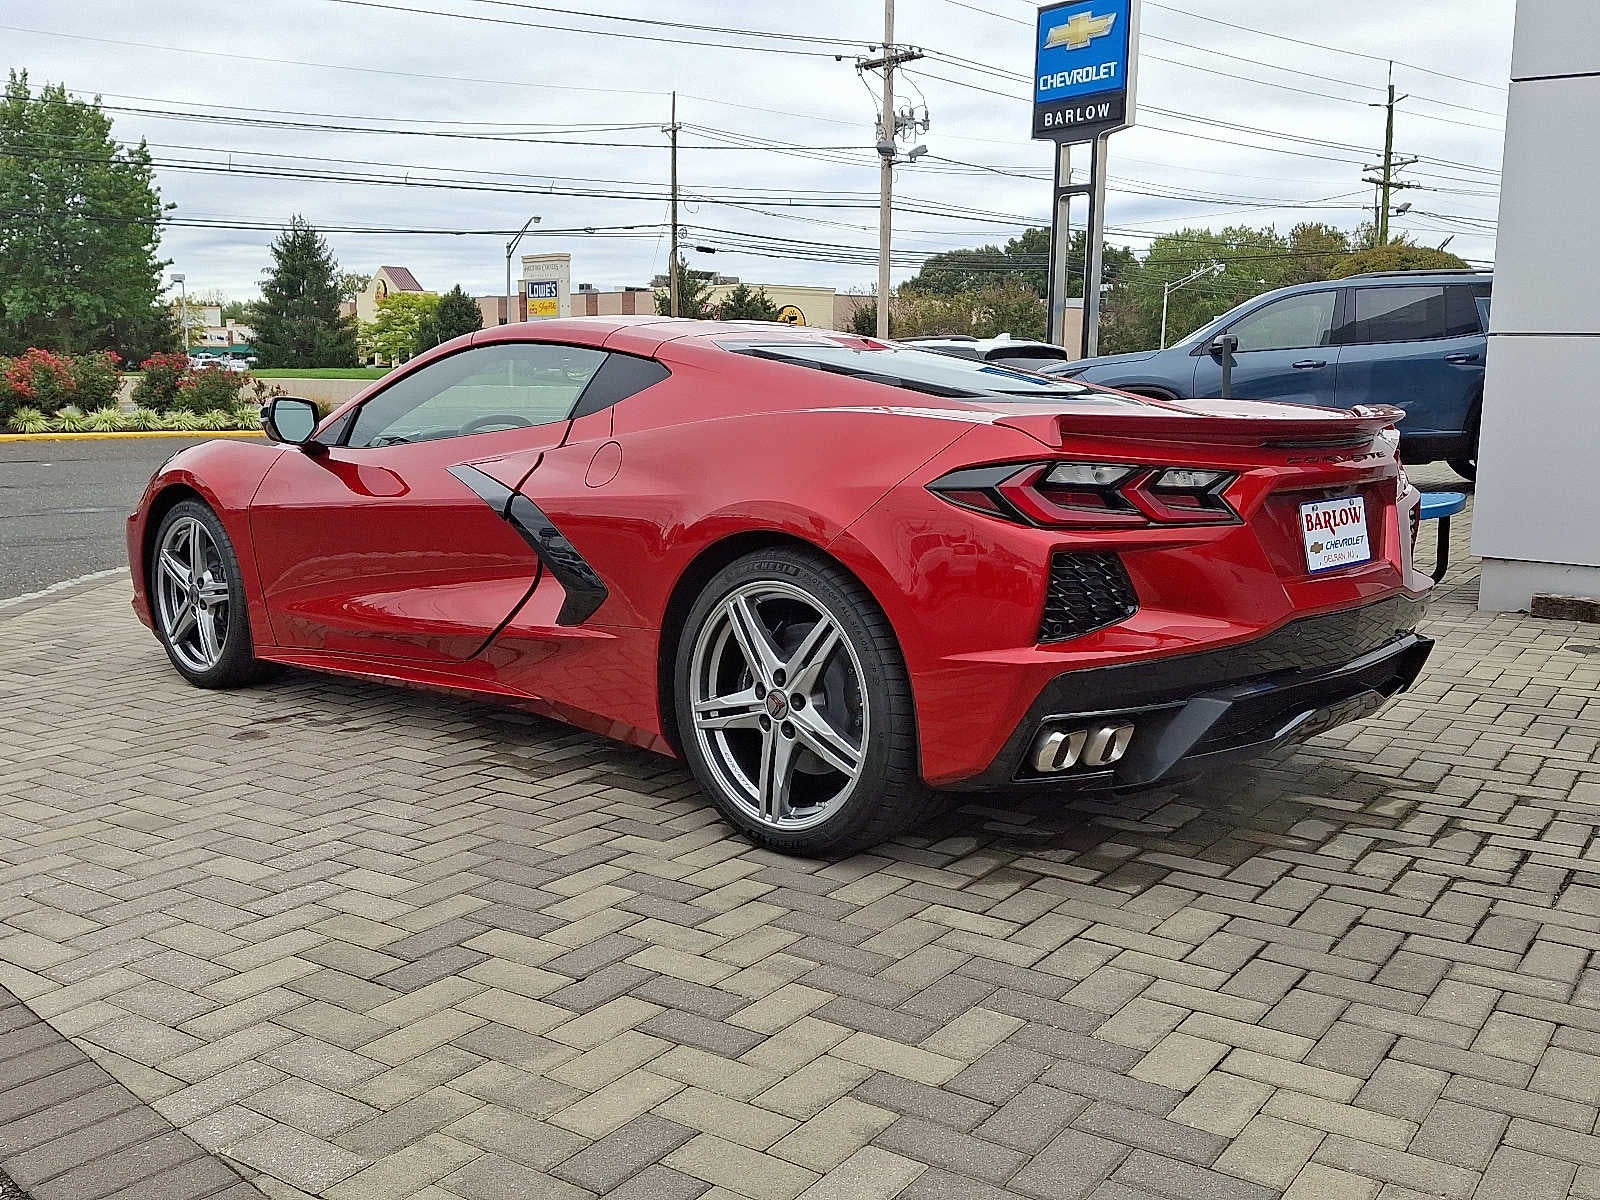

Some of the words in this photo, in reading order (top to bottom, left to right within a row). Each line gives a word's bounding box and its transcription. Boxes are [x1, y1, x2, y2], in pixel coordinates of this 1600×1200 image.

[1040, 61, 1117, 91] CHEVROLET
[1044, 102, 1110, 127] BARLOW
[529, 282, 556, 298] LOWE'S
[1305, 506, 1362, 536] BARLOW
[1325, 535, 1364, 550] CHEVROLET
